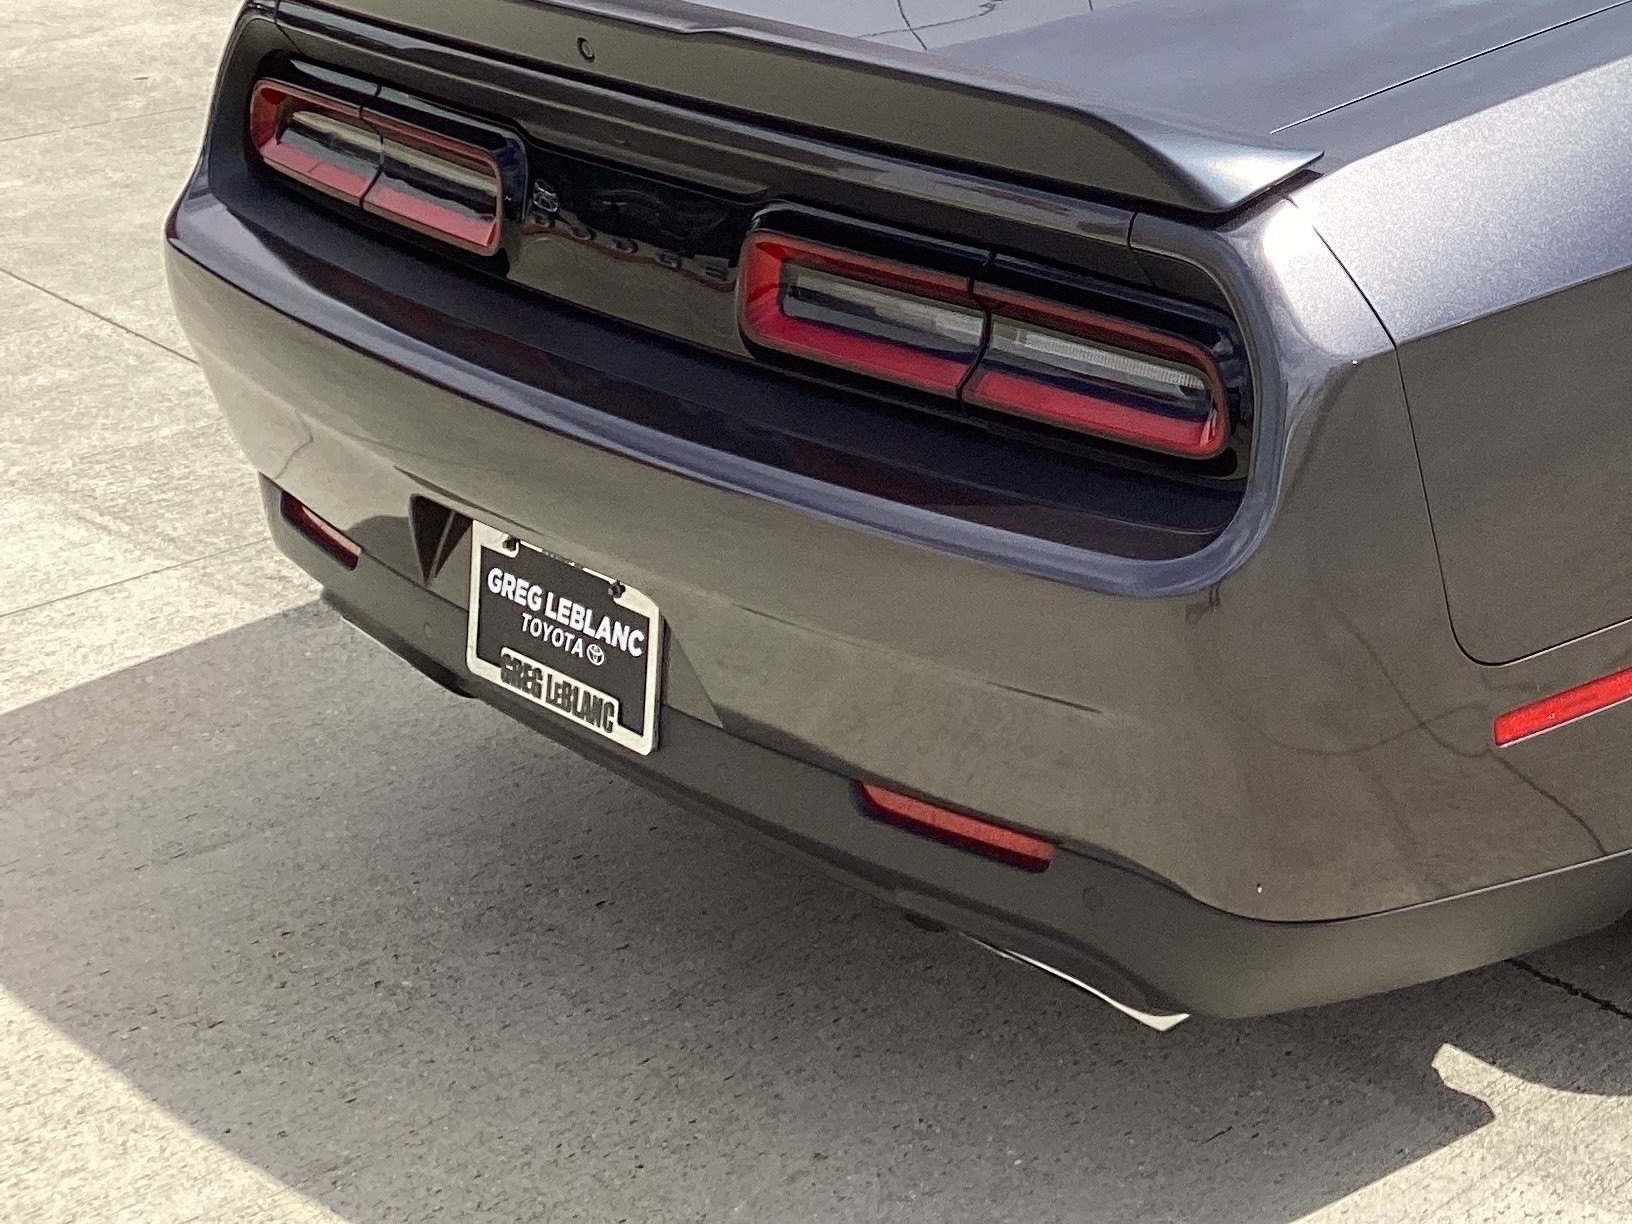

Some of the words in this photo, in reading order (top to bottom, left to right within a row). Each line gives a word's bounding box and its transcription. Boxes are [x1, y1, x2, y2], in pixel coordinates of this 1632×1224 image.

[487, 567, 543, 612] GREG
[545, 591, 645, 658] LEBLANC
[521, 612, 585, 659] TOYOTA
[500, 652, 544, 700] GREG
